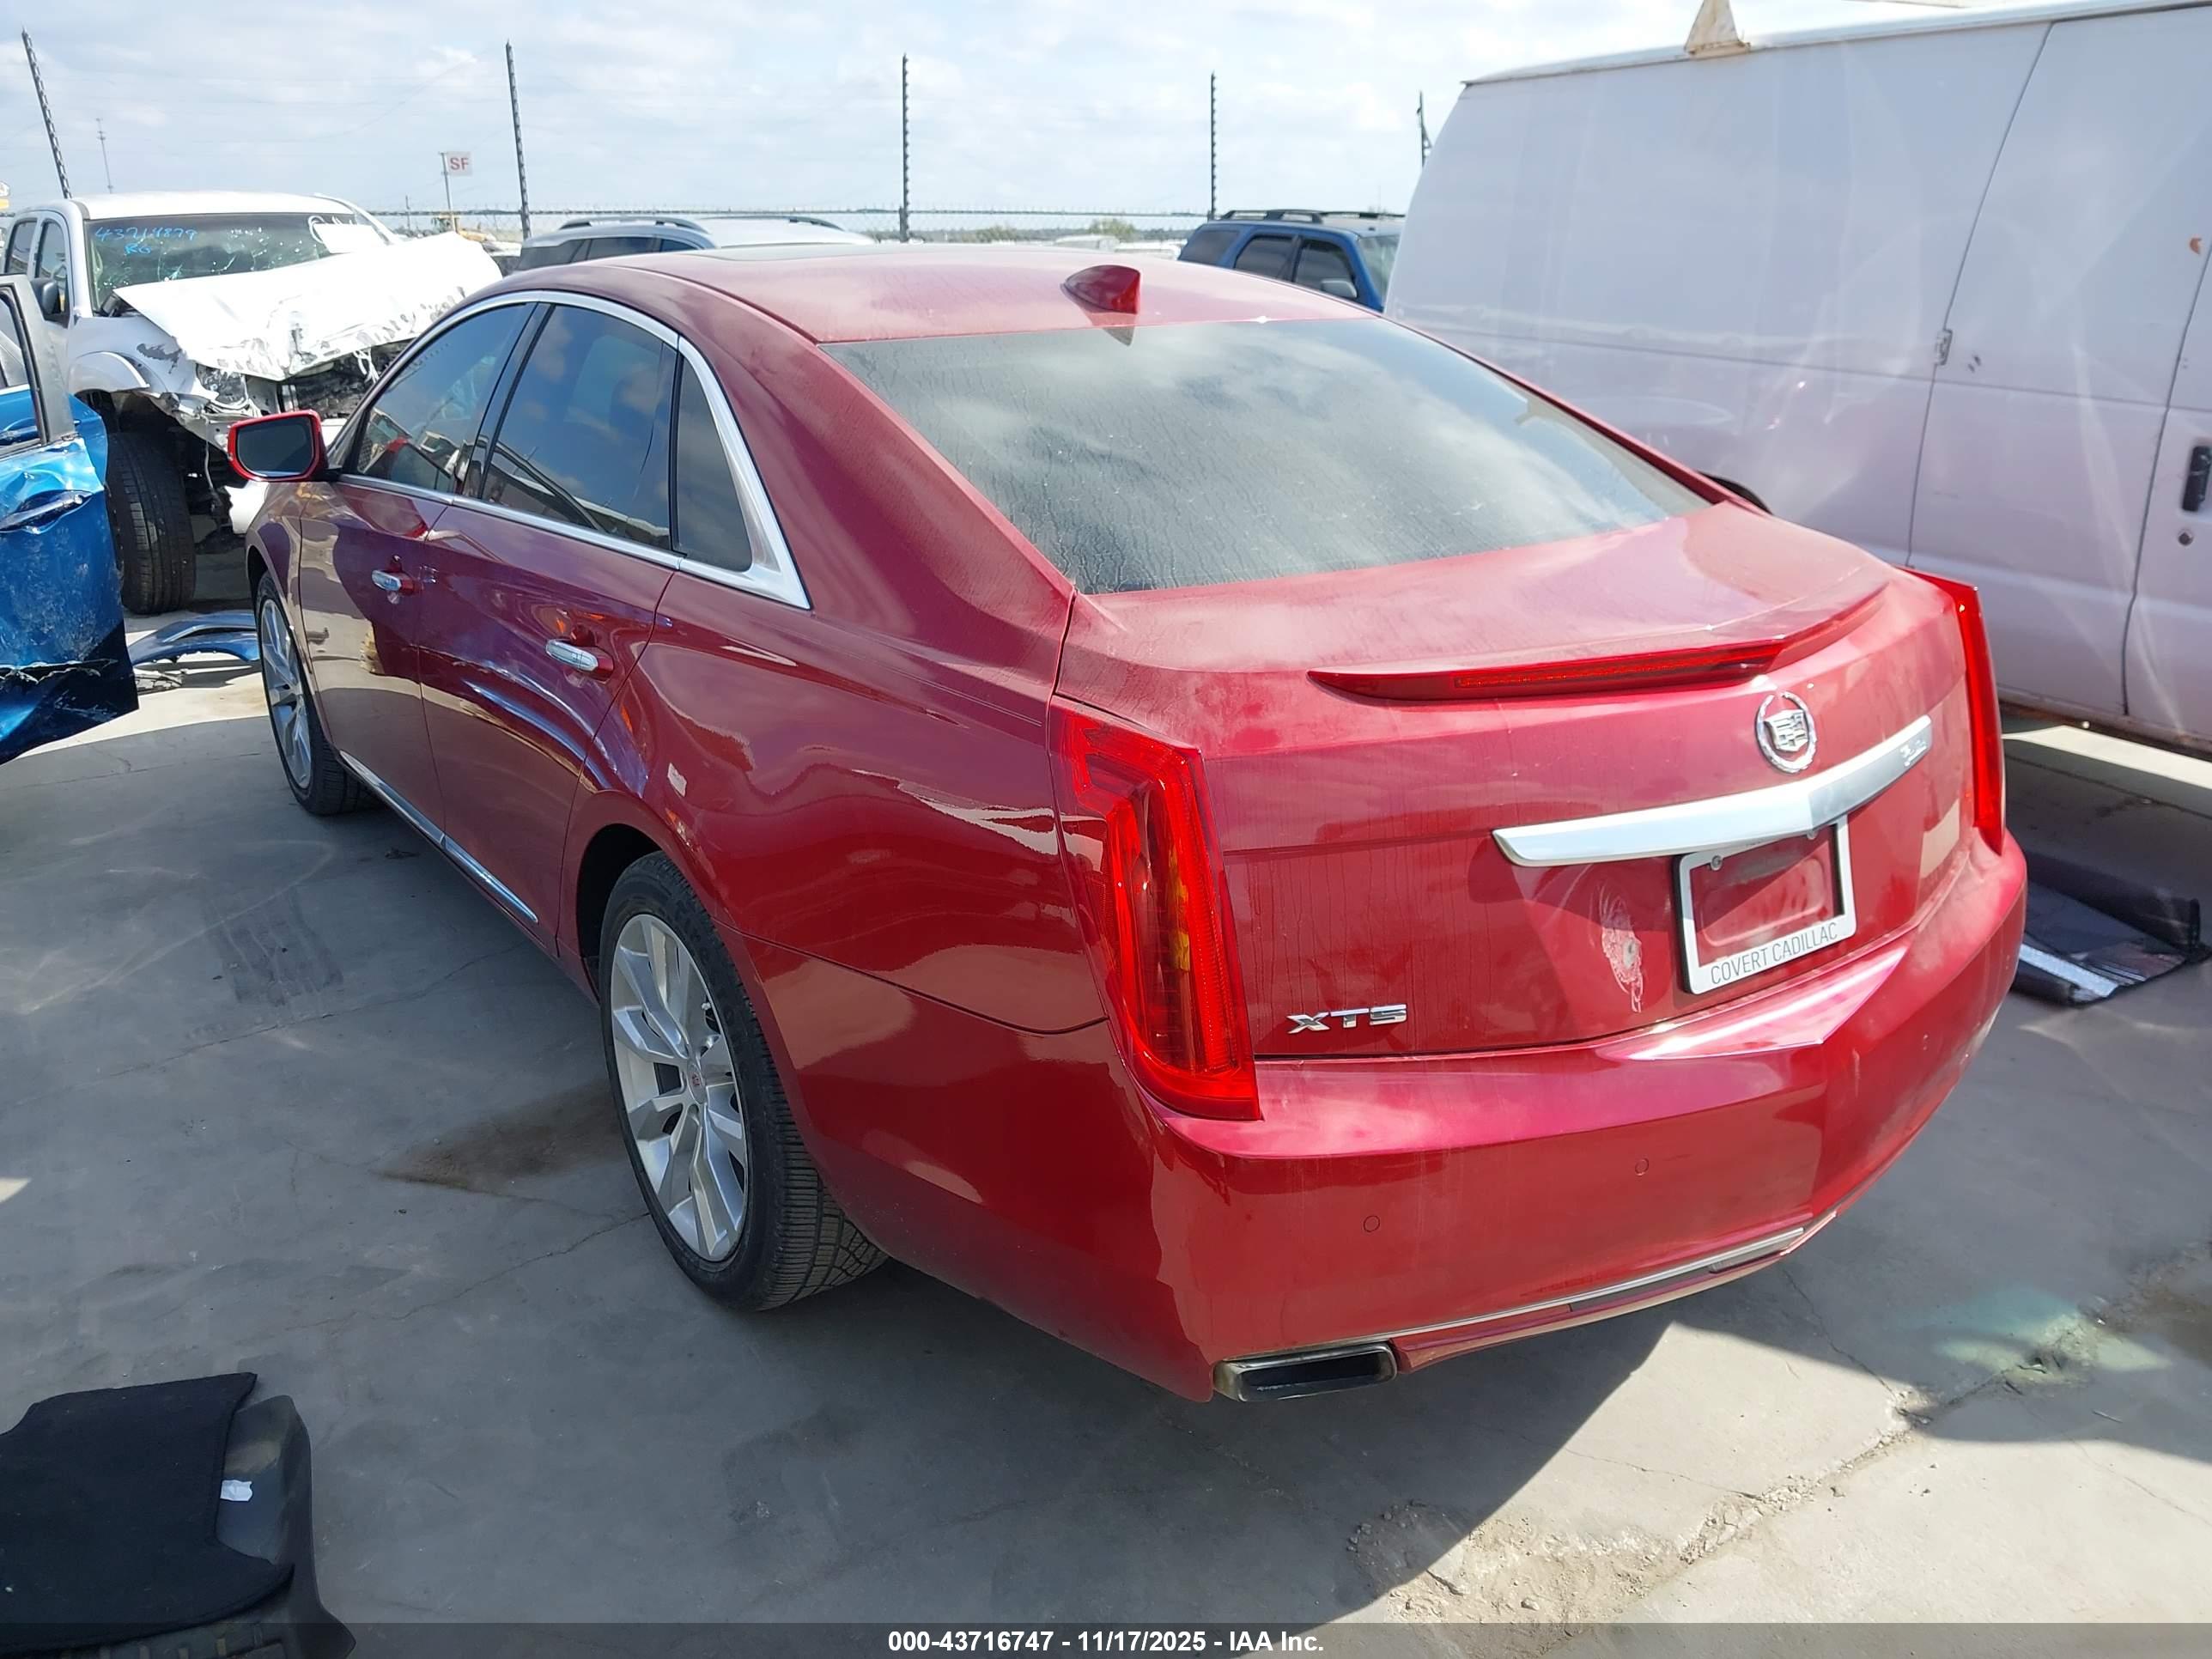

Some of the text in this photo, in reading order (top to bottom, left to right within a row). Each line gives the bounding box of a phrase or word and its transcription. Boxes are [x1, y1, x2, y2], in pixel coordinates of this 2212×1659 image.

[450, 157, 469, 170] SF
[1711, 922, 1838, 984] COVERT CADILLAC
[1286, 1004, 1407, 1034] XTS
